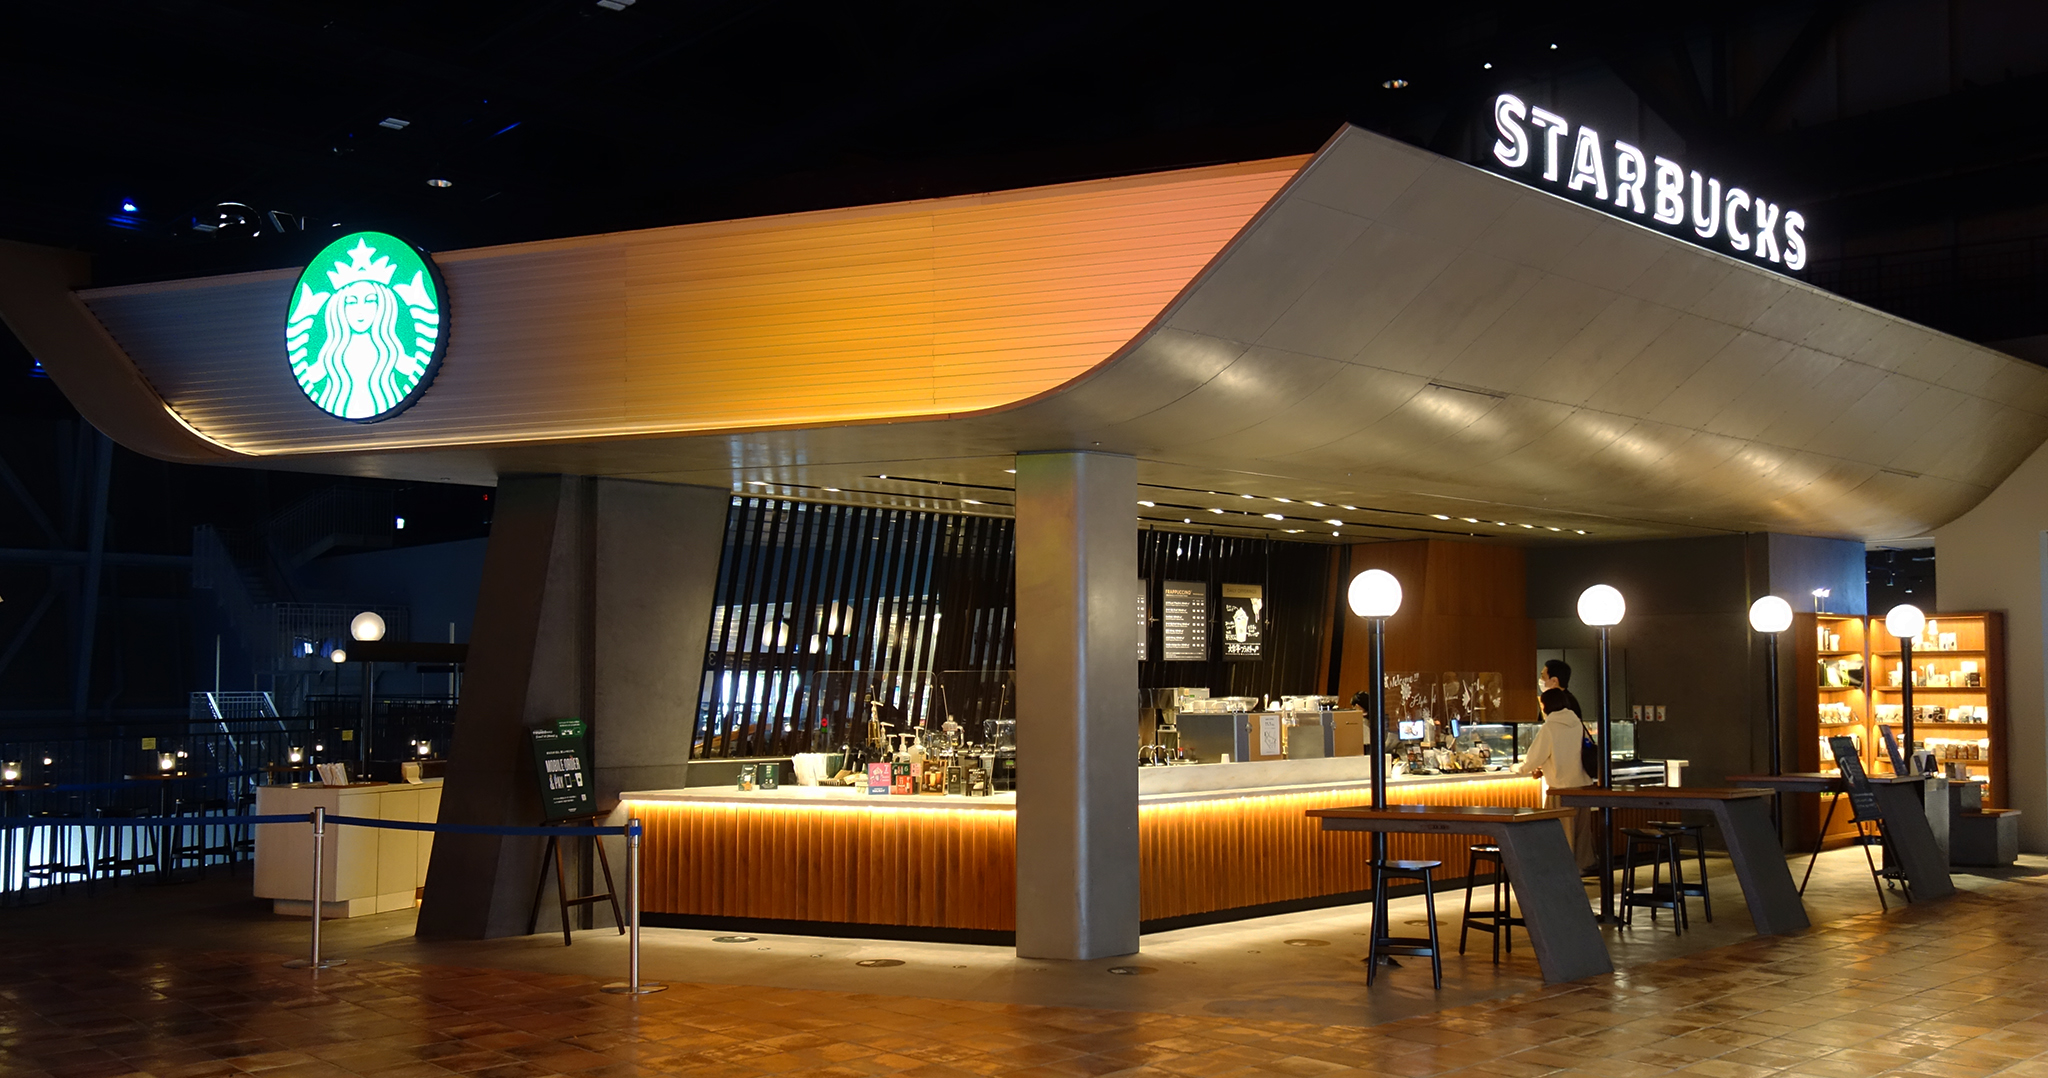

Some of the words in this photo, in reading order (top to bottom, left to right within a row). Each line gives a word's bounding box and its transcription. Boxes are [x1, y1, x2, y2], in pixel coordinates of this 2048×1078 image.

[1493, 93, 1807, 272] STARBUCKS
[545, 759, 565, 773] MOBILE
[564, 757, 580, 771] ORDER
